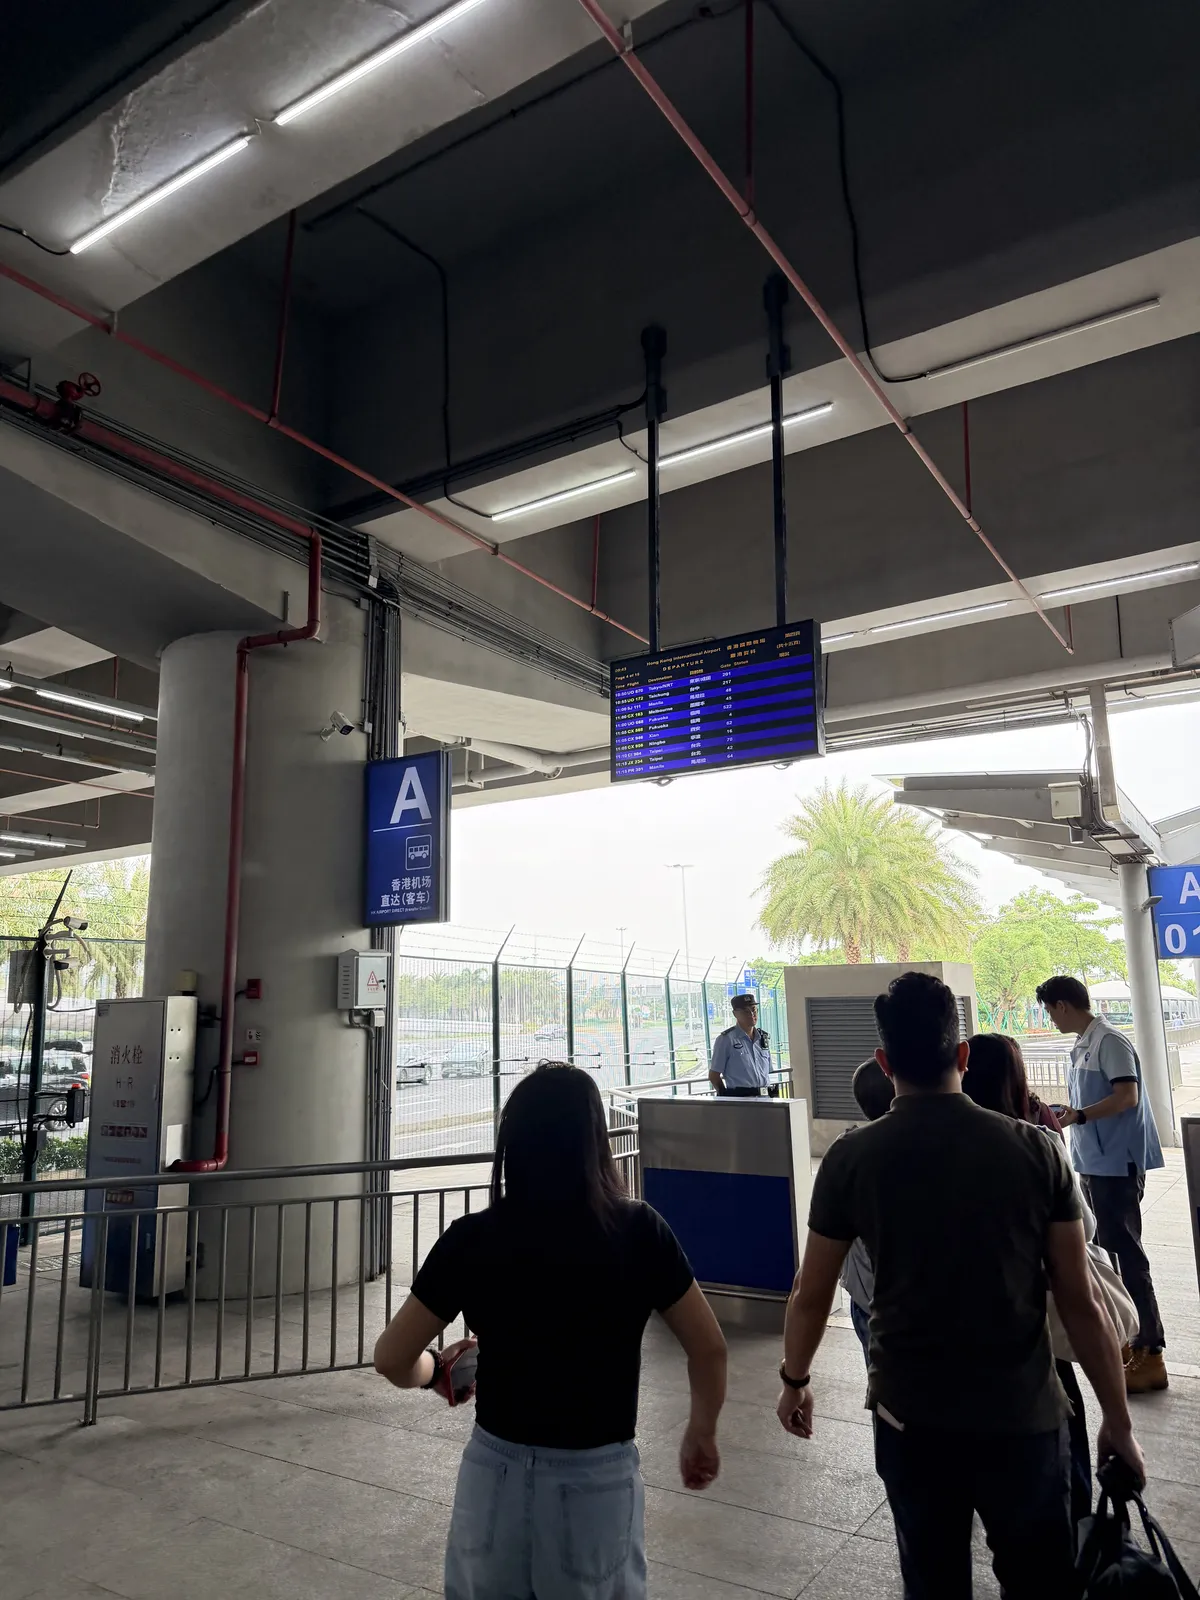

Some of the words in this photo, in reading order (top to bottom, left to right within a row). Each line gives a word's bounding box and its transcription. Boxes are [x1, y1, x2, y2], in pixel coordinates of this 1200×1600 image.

[673, 650, 702, 660] International
[704, 647, 720, 655] Airport
[662, 659, 703, 671] DEPARTURE
[647, 674, 672, 682] Destination
[648, 691, 669, 699] Taichung
[648, 706, 672, 714] Melbourne
[390, 766, 432, 824] A
[391, 876, 431, 891] 香港机场
[1179, 872, 1200, 904] A
[110, 1045, 143, 1065] 消火栓
